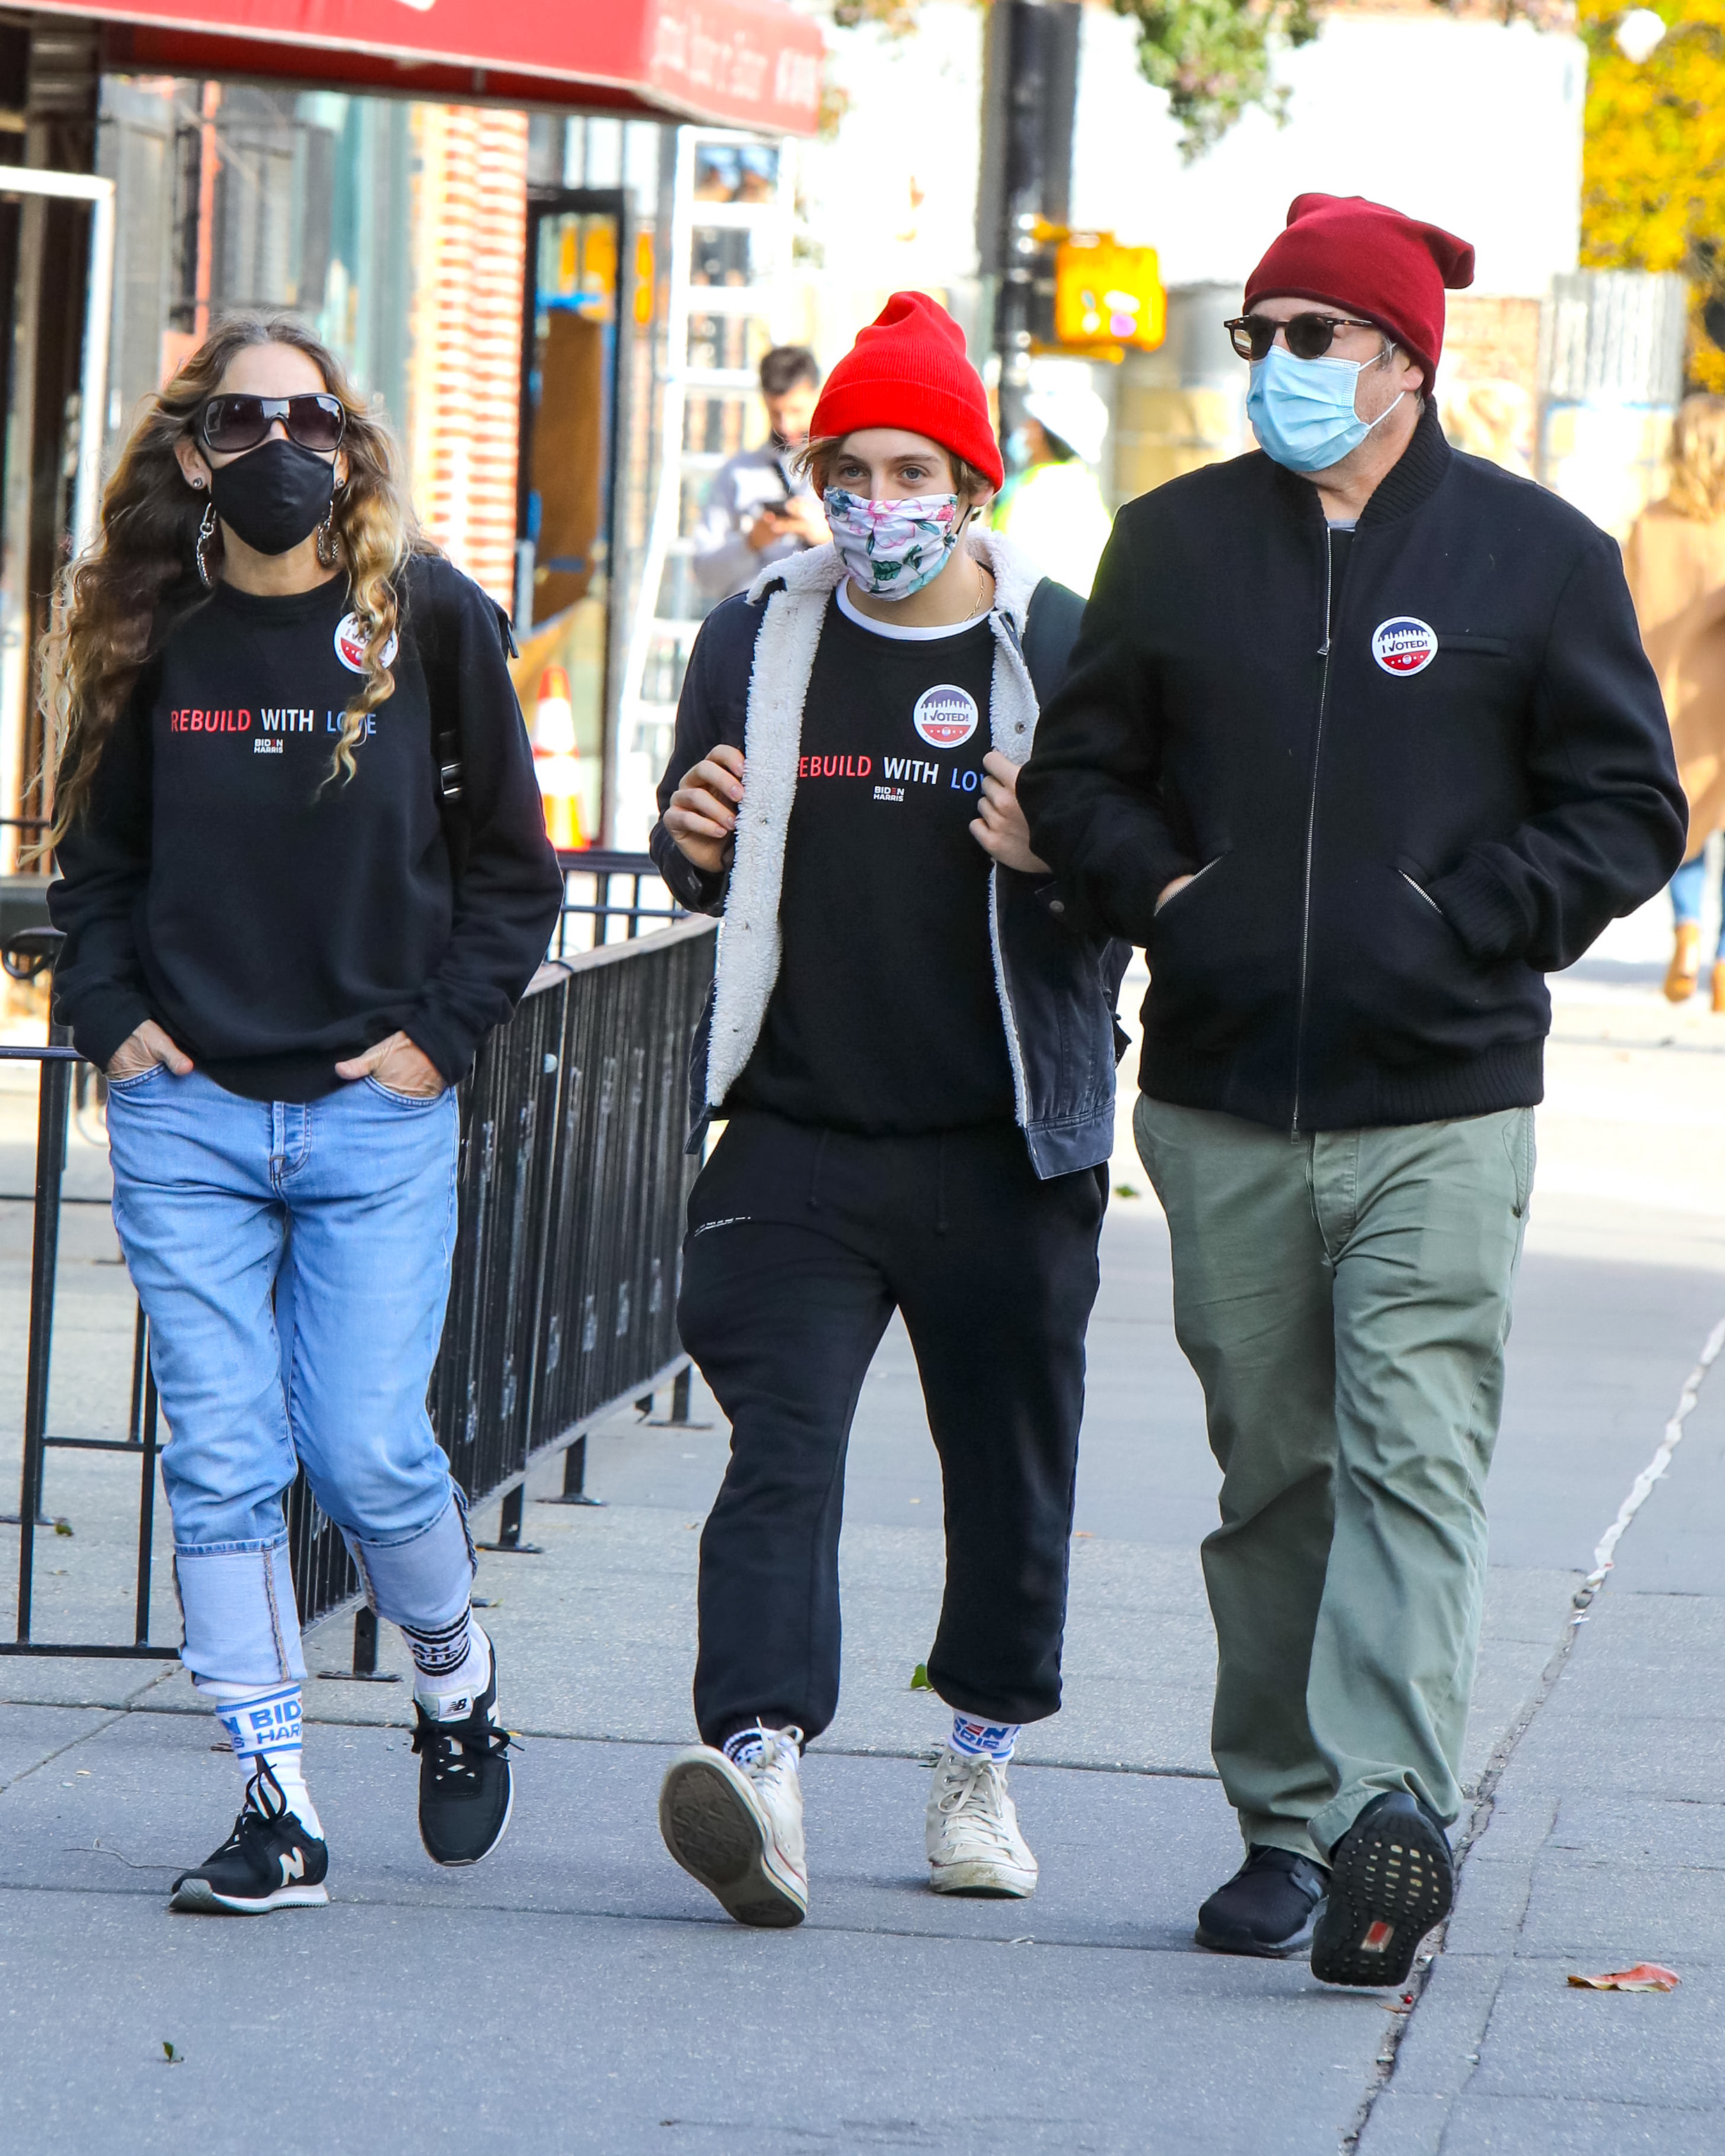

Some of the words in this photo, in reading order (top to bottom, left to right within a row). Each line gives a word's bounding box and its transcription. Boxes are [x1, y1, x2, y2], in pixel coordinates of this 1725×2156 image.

[1388, 640, 1428, 652] VOTED!
[170, 709, 252, 732] REBUILD
[260, 708, 314, 732] WITH
[326, 710, 377, 734] LOE
[929, 709, 969, 722] VOTED!
[799, 755, 872, 778] EBUILD
[883, 756, 939, 785] WITH
[950, 767, 984, 794] LO
[873, 793, 904, 802] HARRIS
[248, 1699, 302, 1731] BID
[255, 1723, 302, 1744] HAR
[278, 1846, 305, 1888] N
